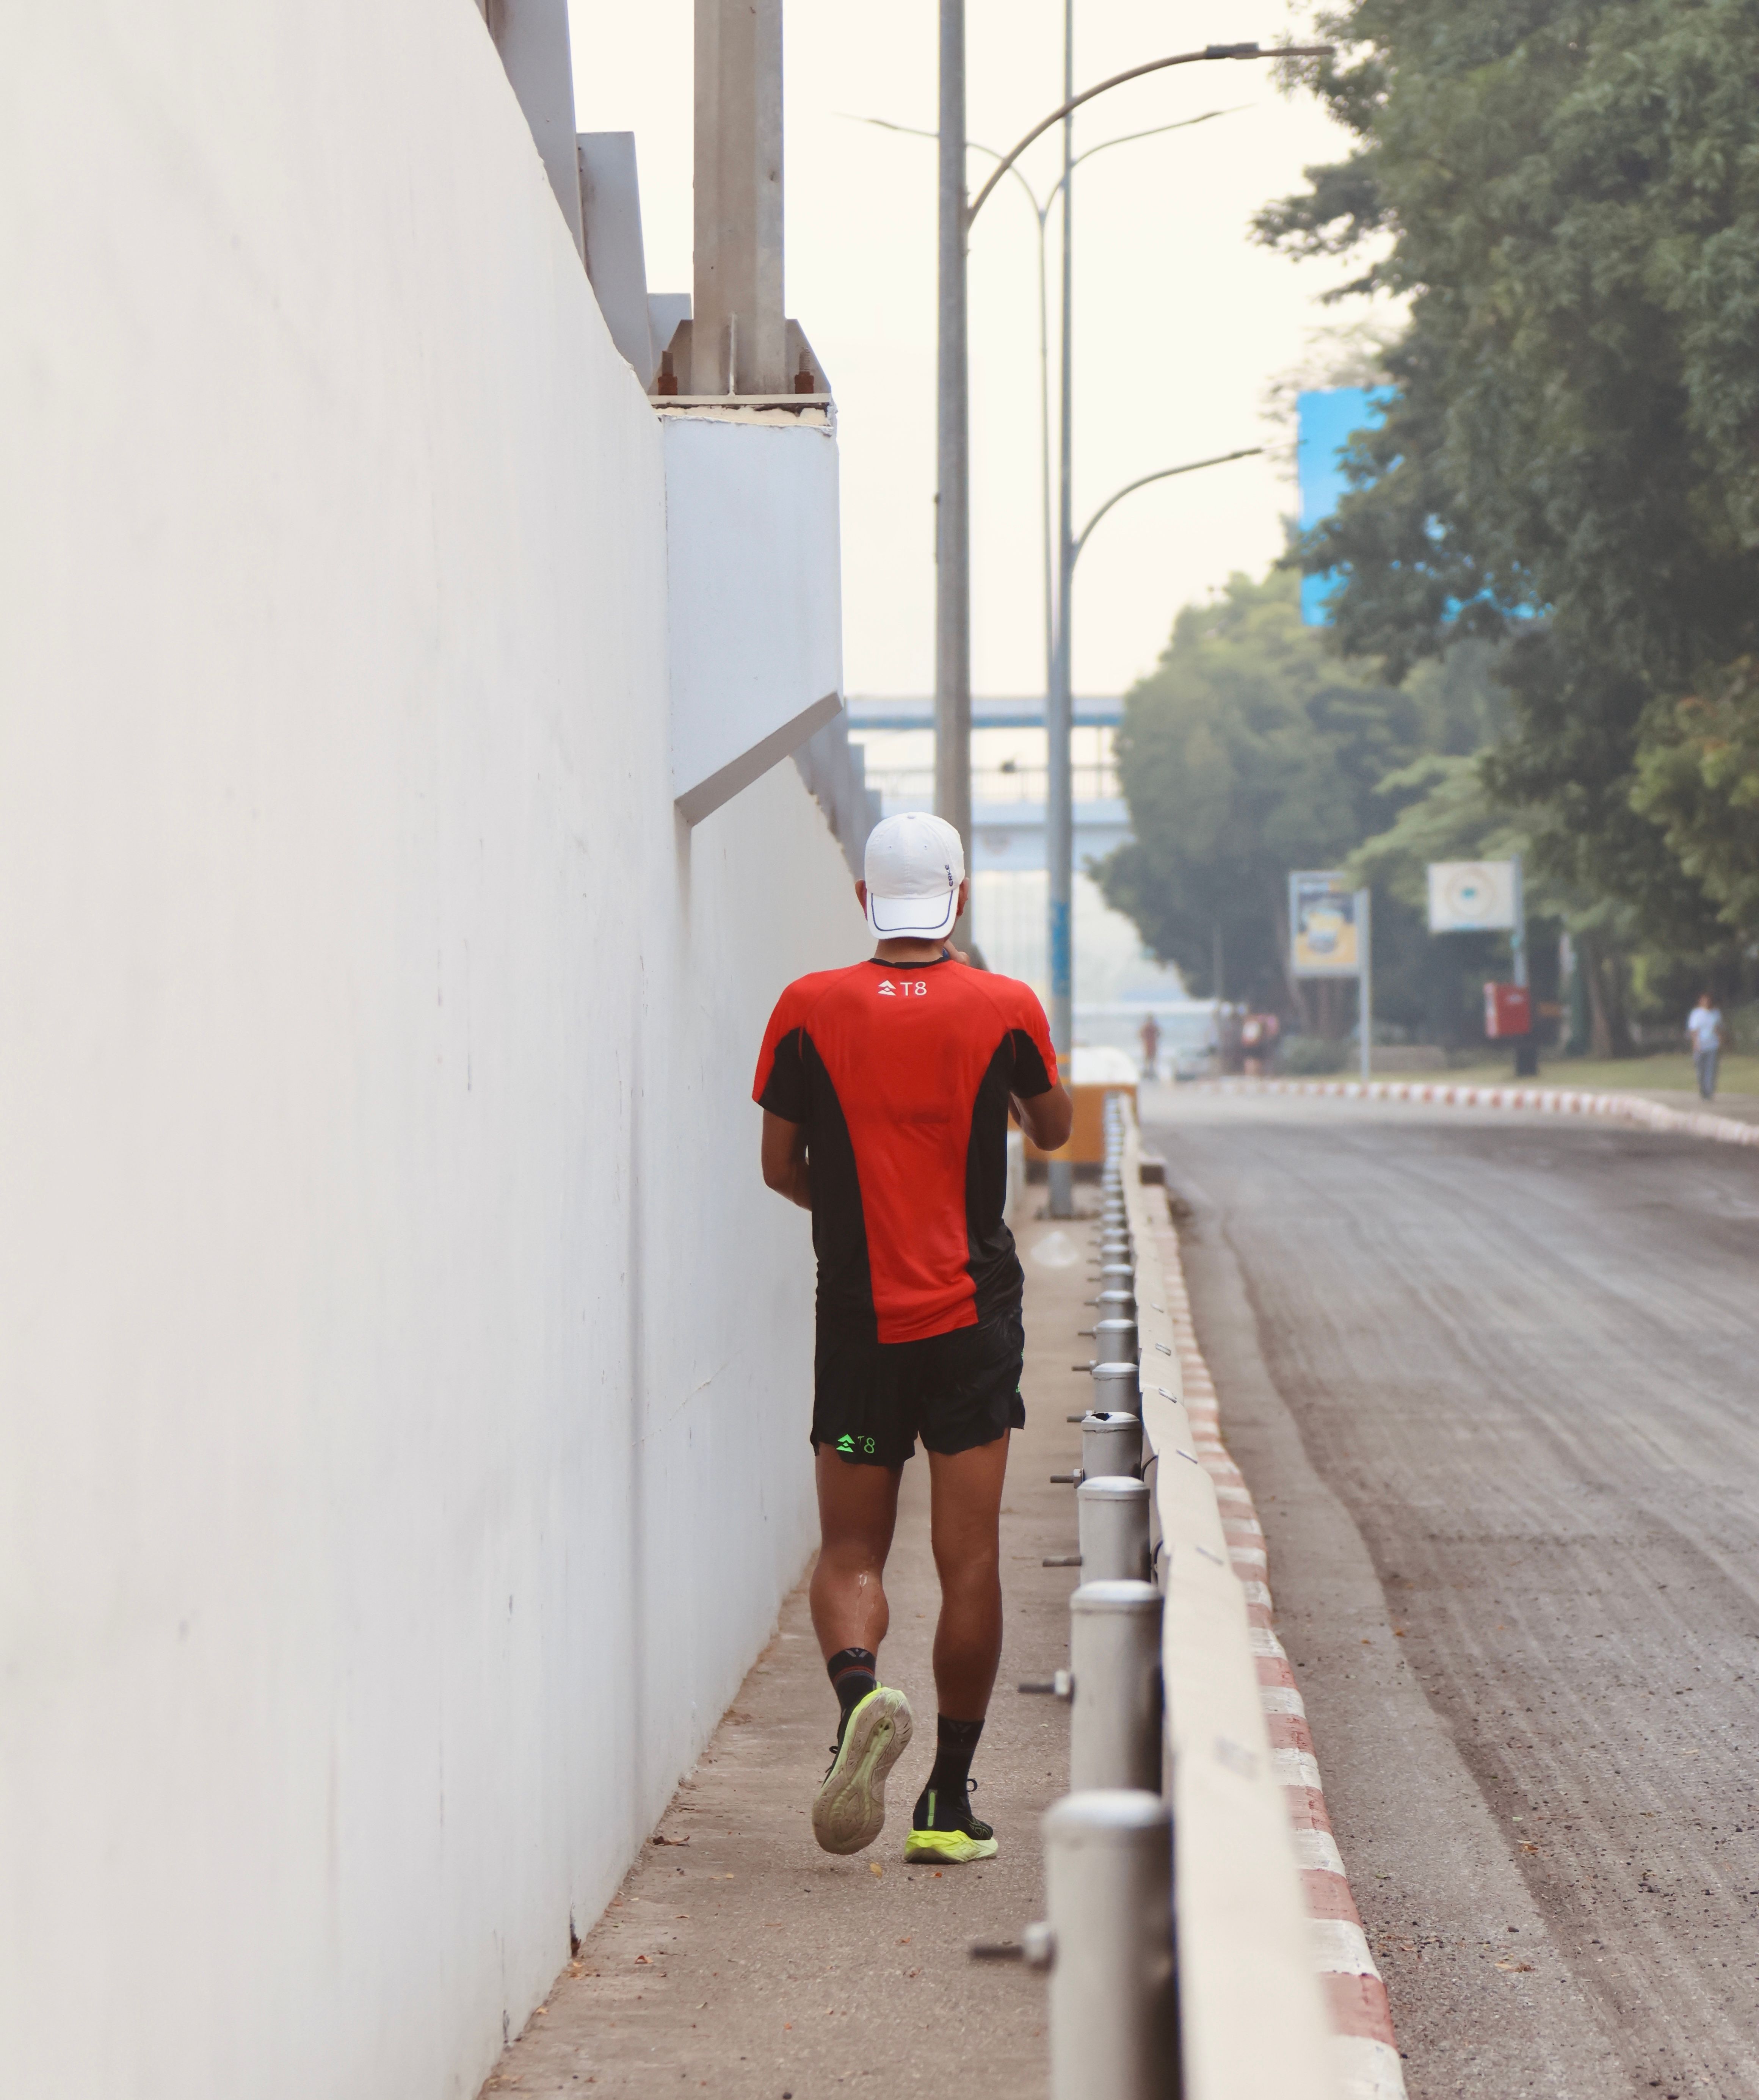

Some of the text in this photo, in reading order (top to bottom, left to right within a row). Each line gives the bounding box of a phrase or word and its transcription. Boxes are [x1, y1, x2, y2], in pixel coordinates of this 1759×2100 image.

[944, 864, 953, 887] ERKE
[900, 981, 927, 996] T8
[858, 1436, 875, 1453] T8
